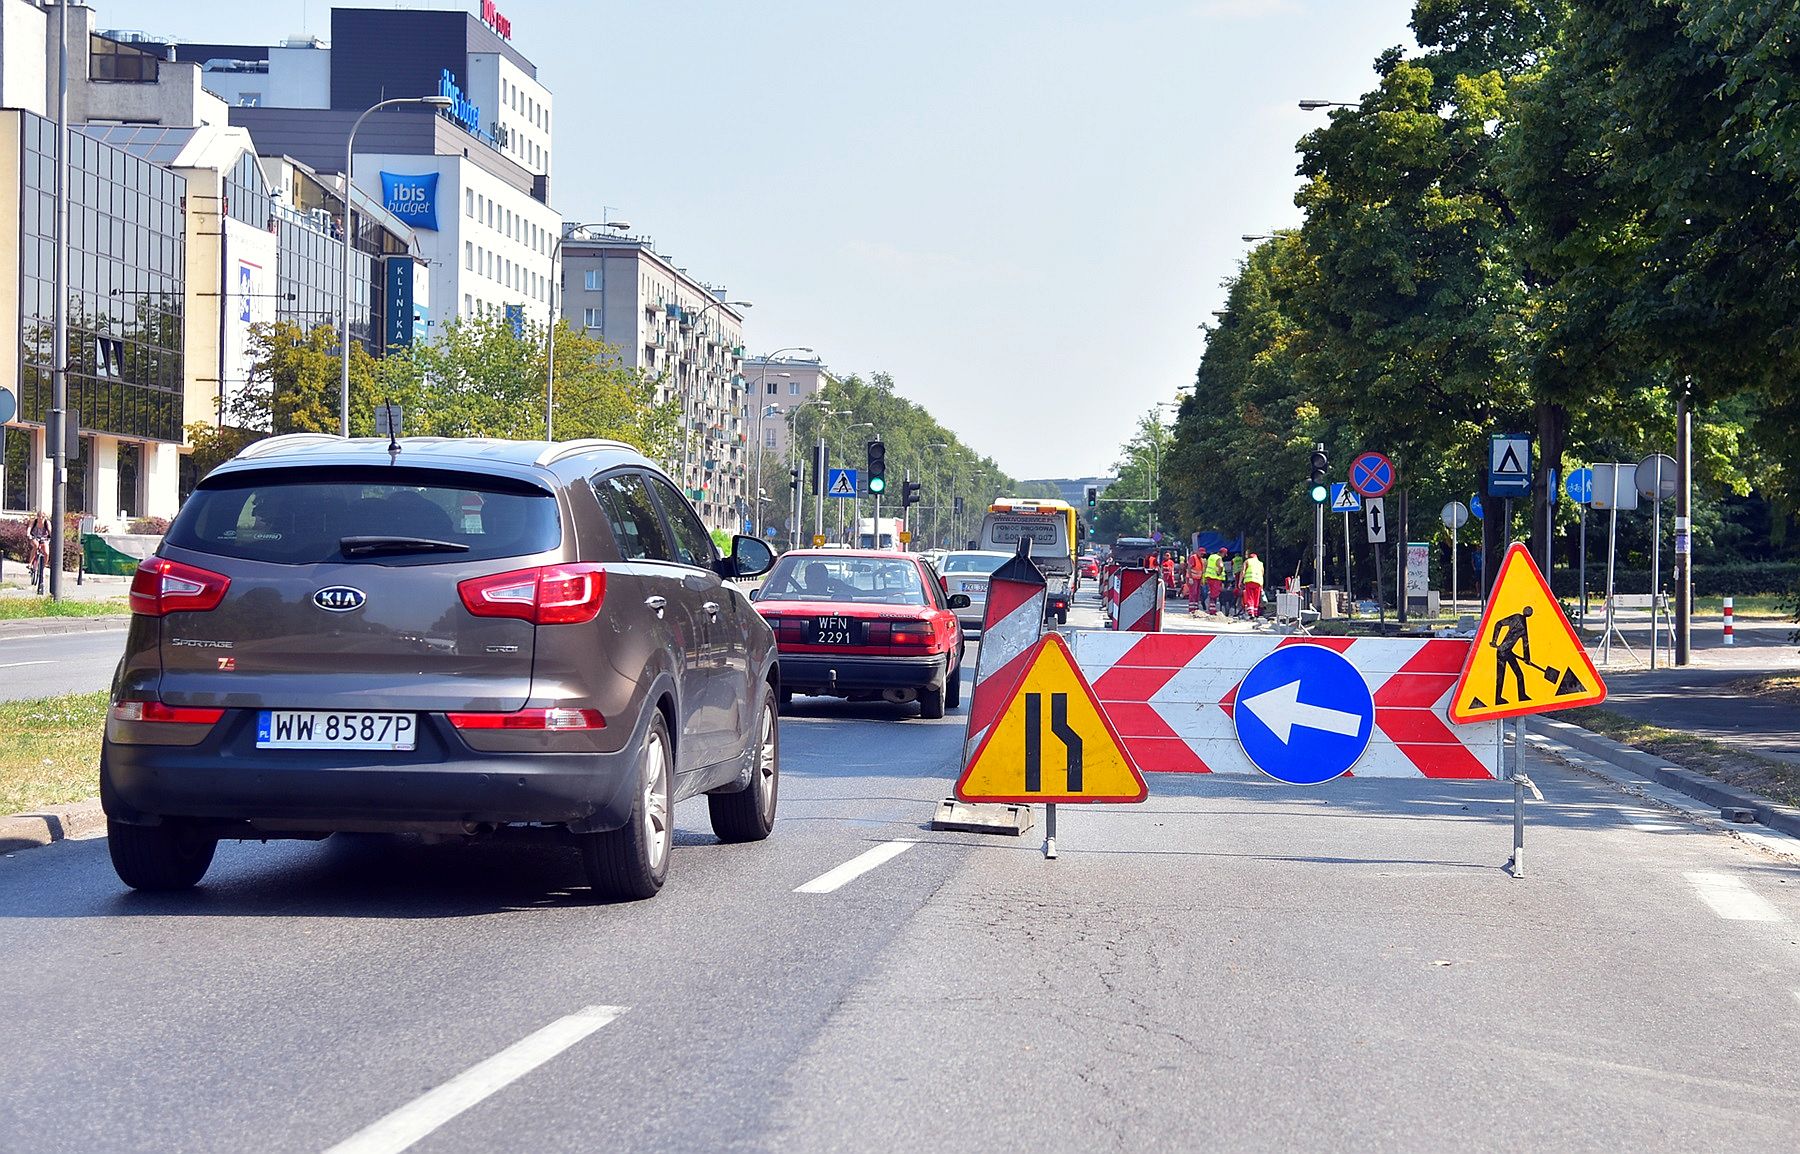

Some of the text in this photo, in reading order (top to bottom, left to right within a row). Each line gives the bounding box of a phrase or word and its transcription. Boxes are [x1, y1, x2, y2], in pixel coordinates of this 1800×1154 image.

[393, 183, 426, 201] ibis
[387, 199, 431, 216] budget
[395, 266, 404, 340] KLINIKA
[321, 592, 357, 606] KIA
[818, 616, 848, 630] WFN
[818, 631, 850, 644] 2291
[259, 731, 270, 739] PL
[276, 714, 412, 742] WW 8587P
